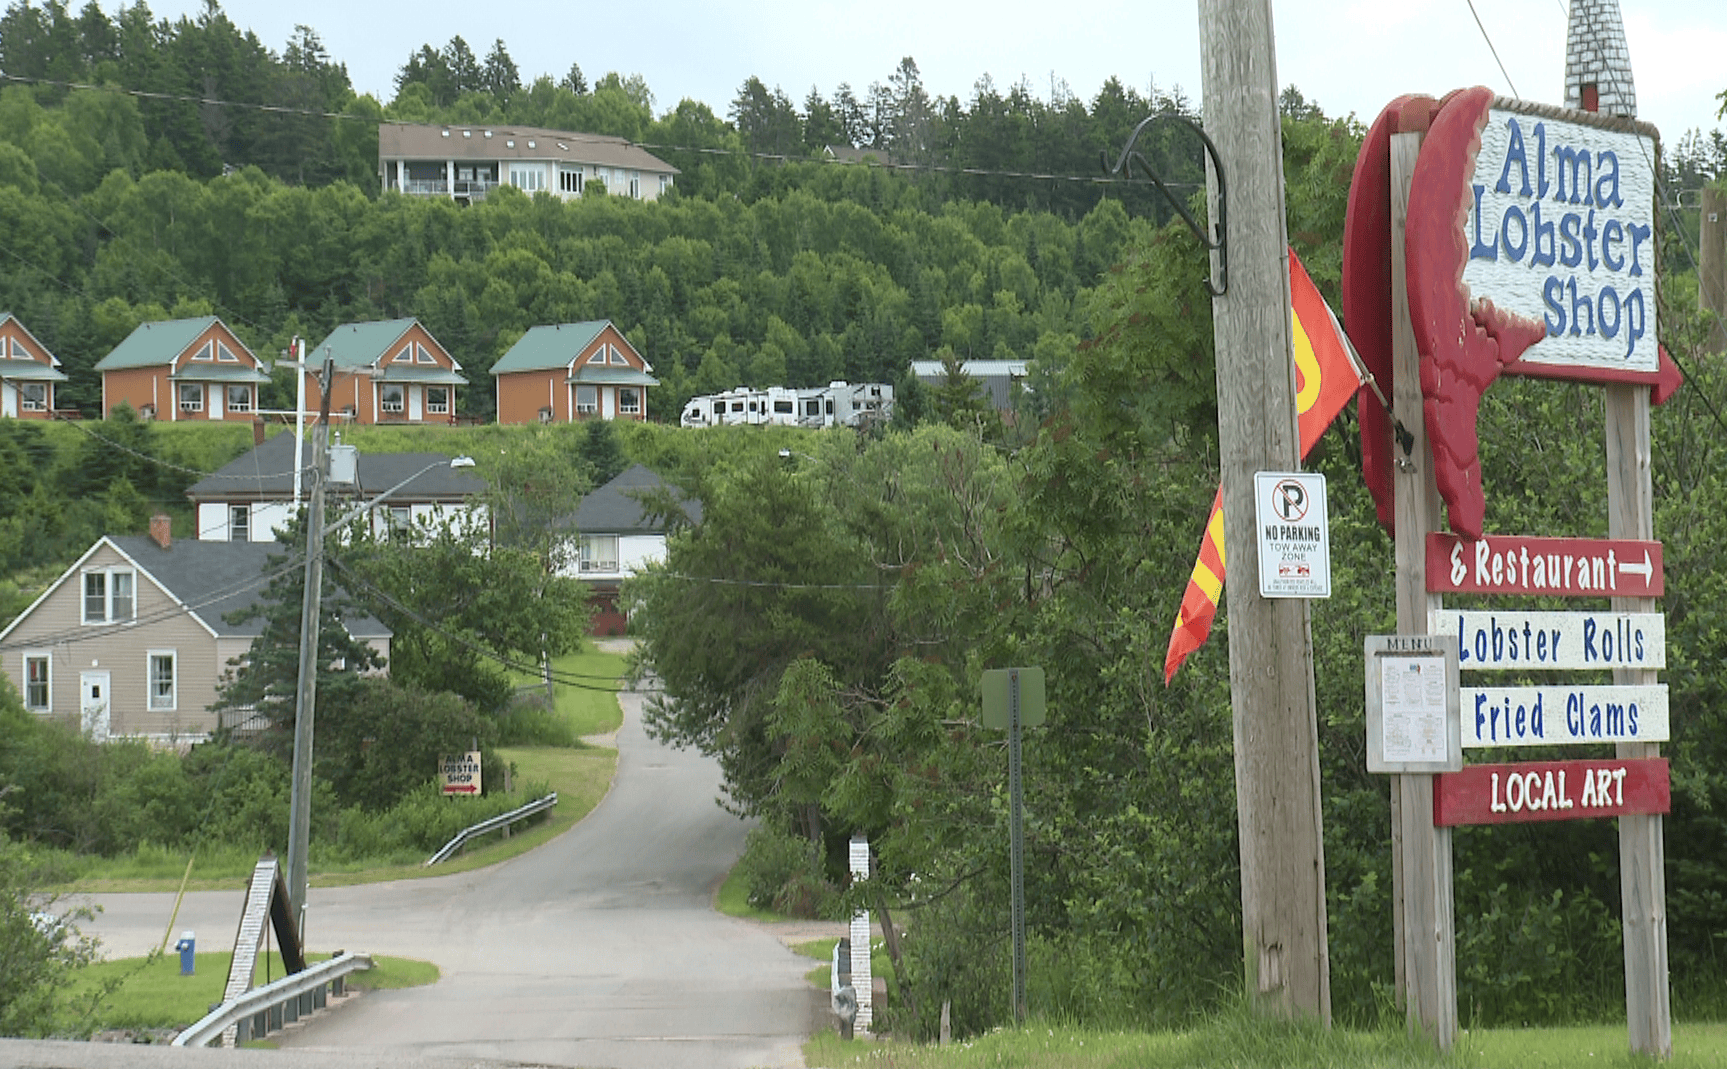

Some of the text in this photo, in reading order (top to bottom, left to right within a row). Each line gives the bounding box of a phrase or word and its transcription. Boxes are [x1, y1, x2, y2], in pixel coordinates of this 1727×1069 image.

[1495, 117, 1624, 209] Alma
[1470, 185, 1651, 276] Lobster
[1543, 275, 1645, 359] Shop
[1265, 525, 1321, 542] NO PARKING
[1270, 543, 1318, 552] TOW AWAY
[1281, 553, 1306, 561] ZONE
[1450, 538, 1617, 590] & Restaurant
[1387, 638, 1432, 650] MENU
[1459, 615, 1644, 663] Lobster Rolls
[1475, 691, 1544, 741] Fried
[1567, 692, 1638, 737] Clams
[439, 764, 479, 774] LOBSTER
[446, 754, 473, 764] ALMA
[447, 774, 472, 784] SHOP
[1490, 767, 1627, 812] LOCAL ART
